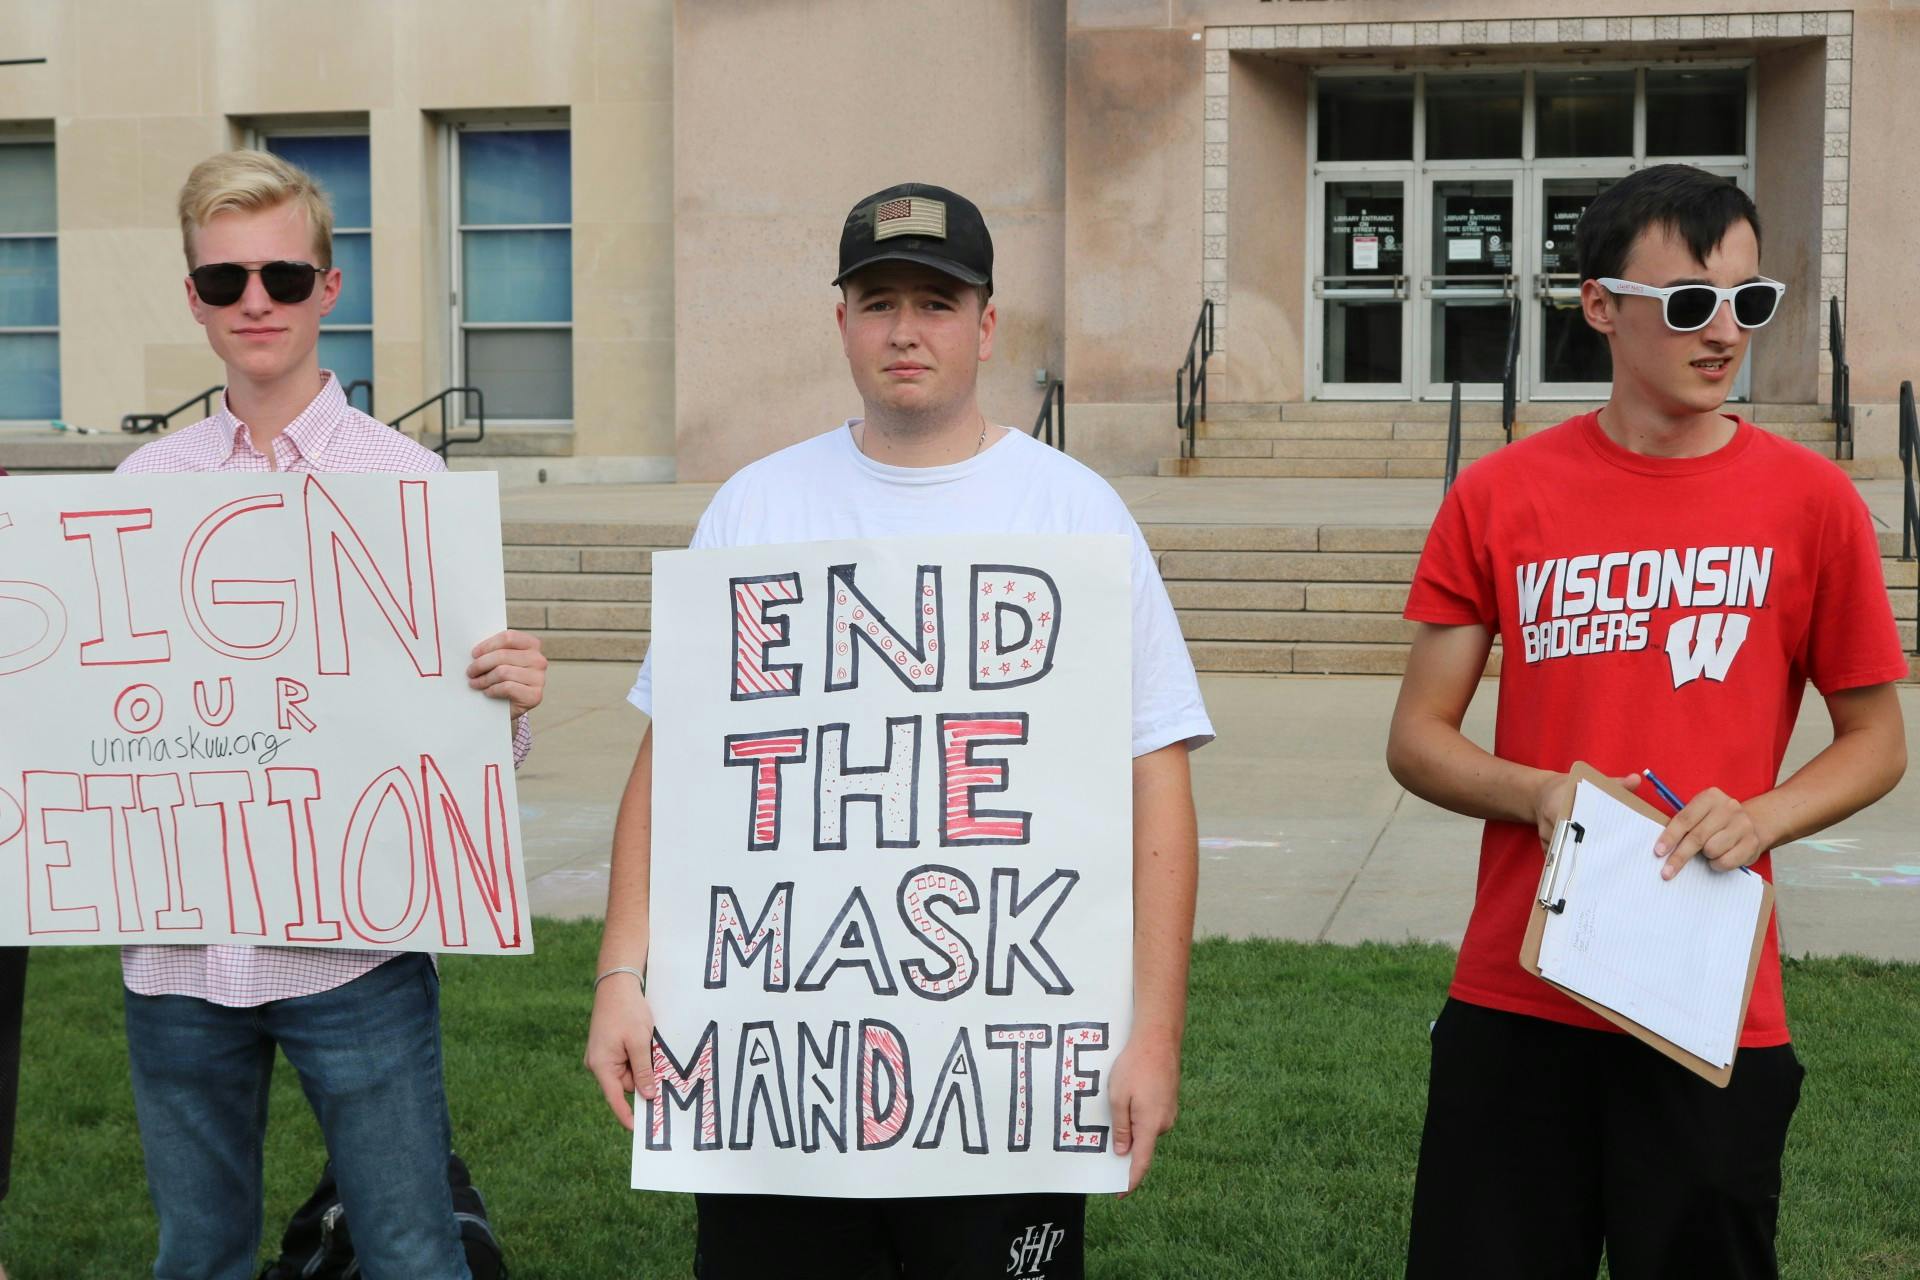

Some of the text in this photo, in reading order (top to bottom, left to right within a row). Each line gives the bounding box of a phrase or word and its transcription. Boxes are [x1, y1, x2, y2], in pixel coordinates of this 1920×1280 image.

[1516, 547, 1773, 626] WISCONSIN
[729, 563, 1061, 701] END
[1522, 612, 1650, 664] BADGERS
[1665, 613, 1750, 689] W
[114, 677, 317, 733] OUR
[91, 725, 291, 765] unmaskuw.org
[724, 712, 1032, 851] THE
[704, 864, 1080, 1001] MASK
[645, 1018, 1110, 1155] MANDATE
